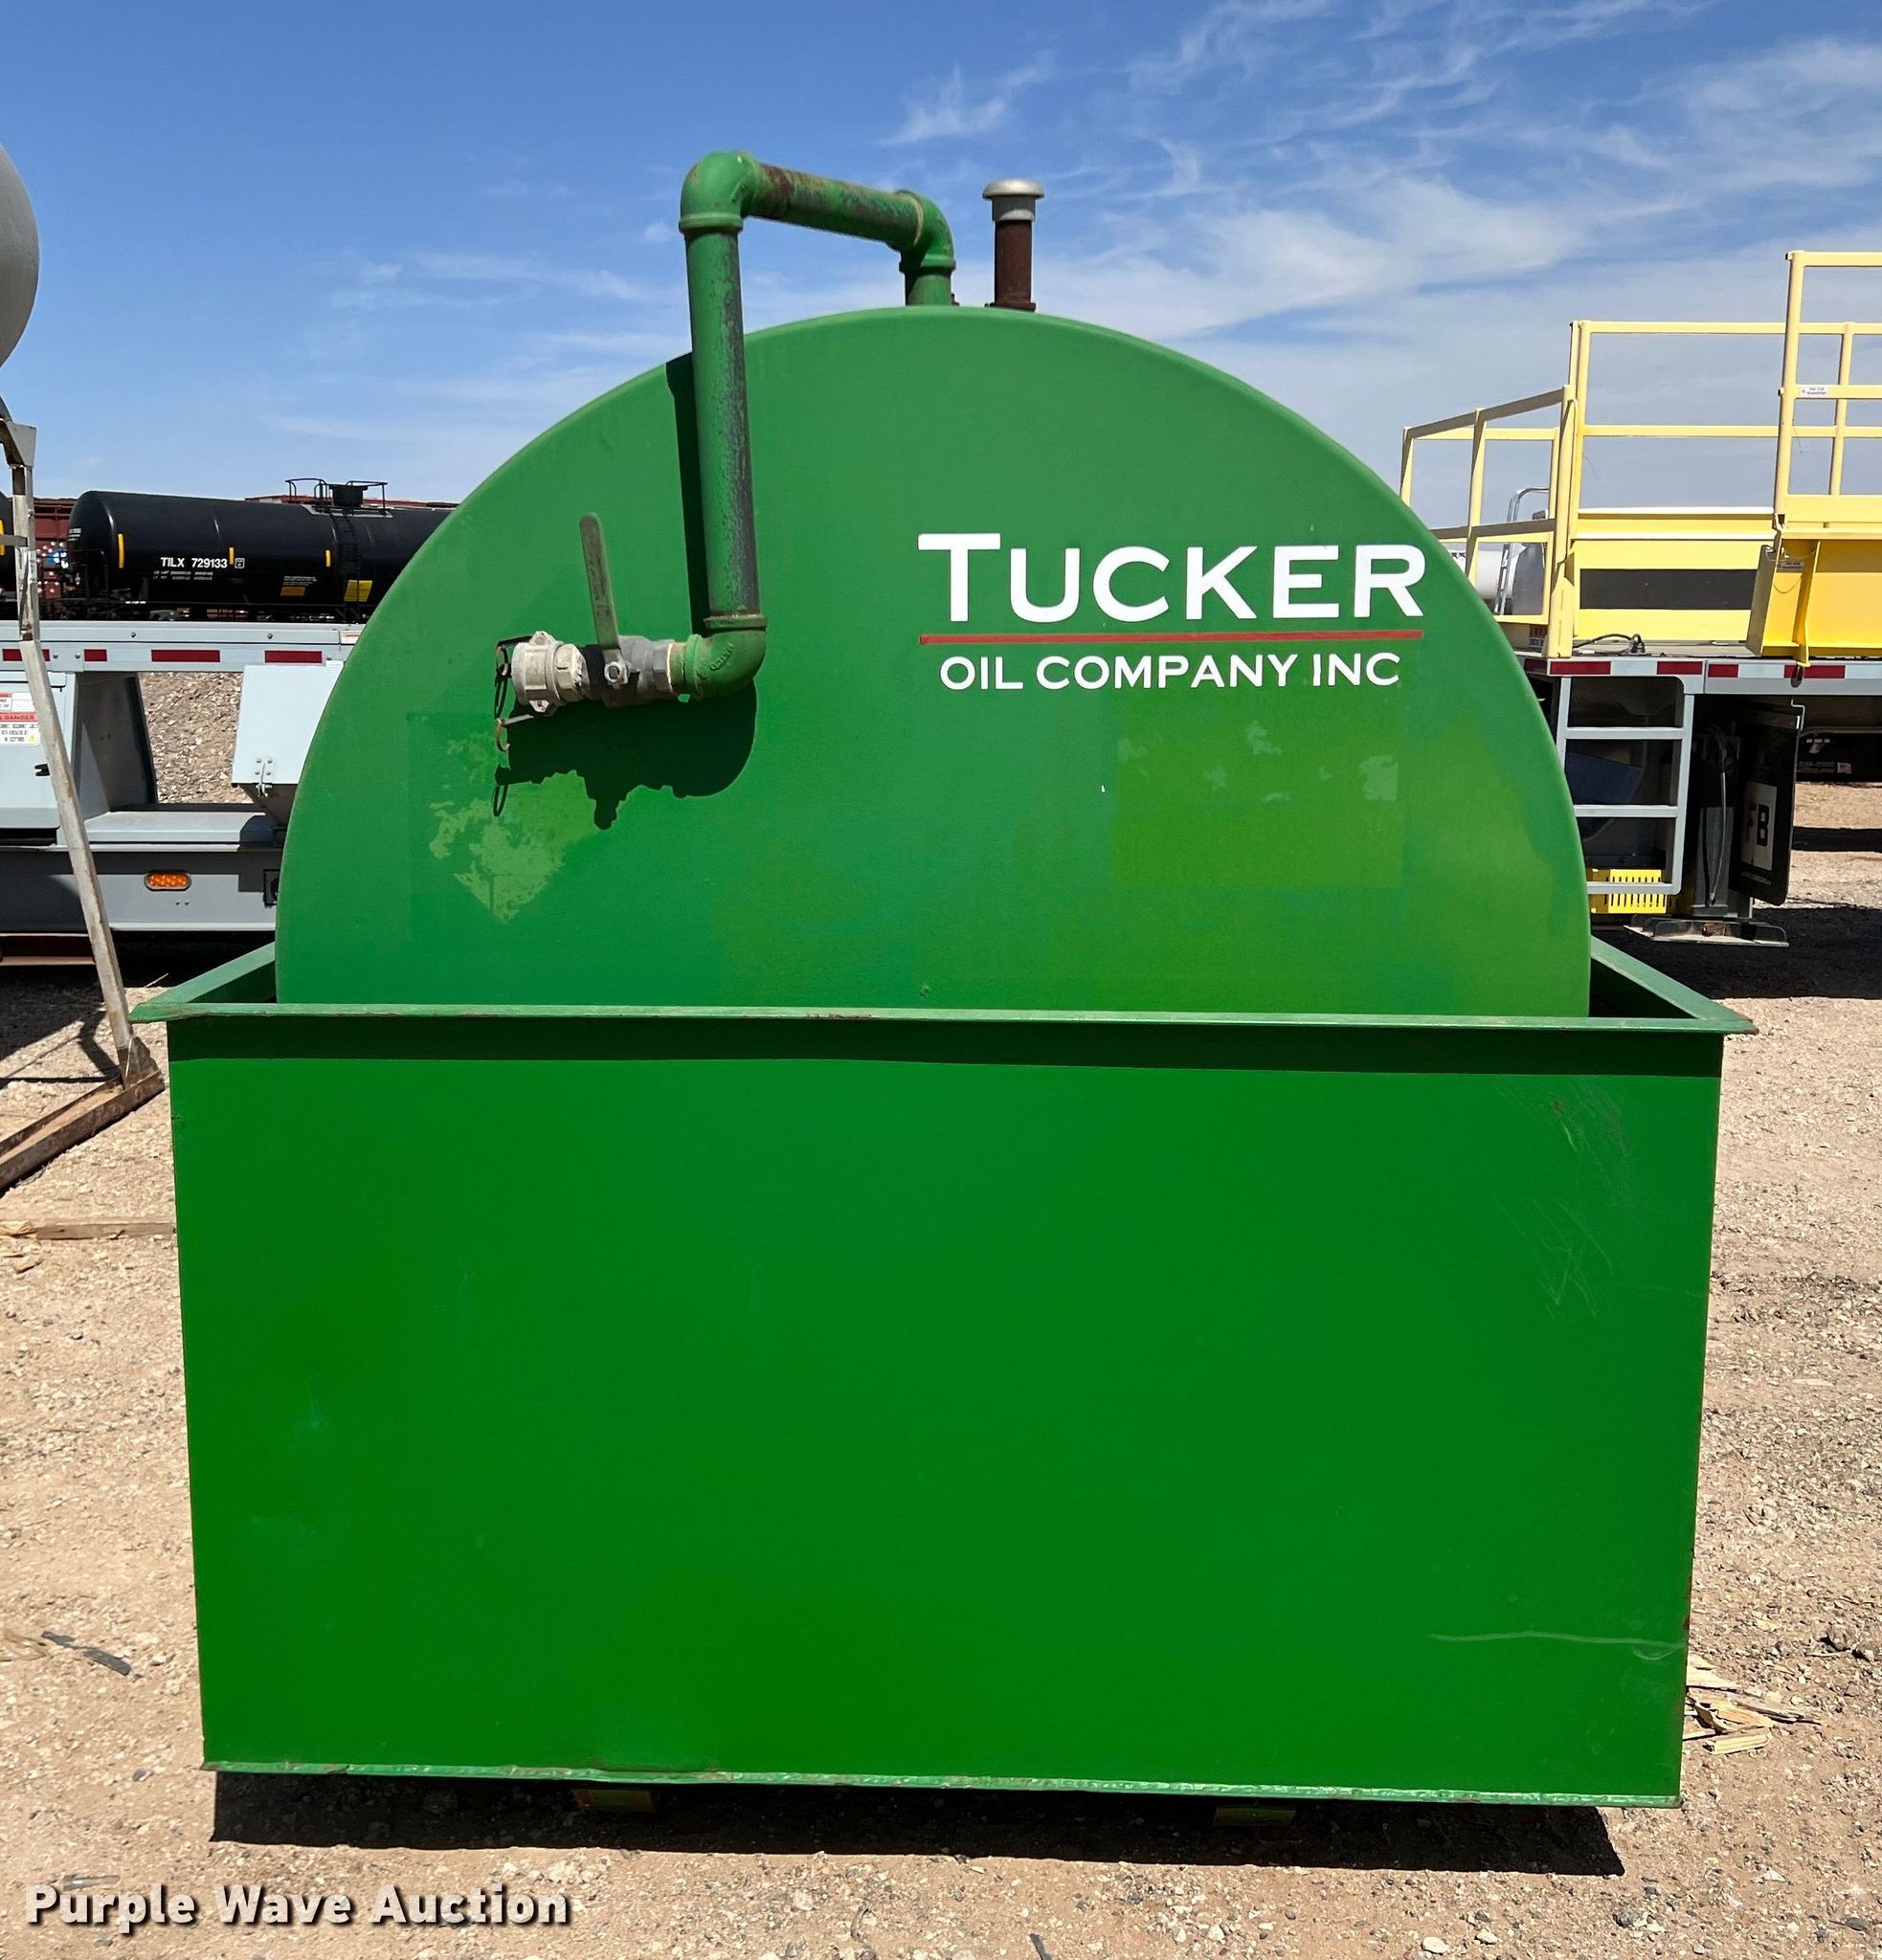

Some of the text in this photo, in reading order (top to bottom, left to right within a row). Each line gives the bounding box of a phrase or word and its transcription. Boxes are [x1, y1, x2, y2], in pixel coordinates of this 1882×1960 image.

[161, 557, 185, 568] TILX
[191, 558, 228, 568] 729133
[918, 533, 1426, 623] TUCKER
[940, 653, 1400, 690] OIL COMPANY INC
